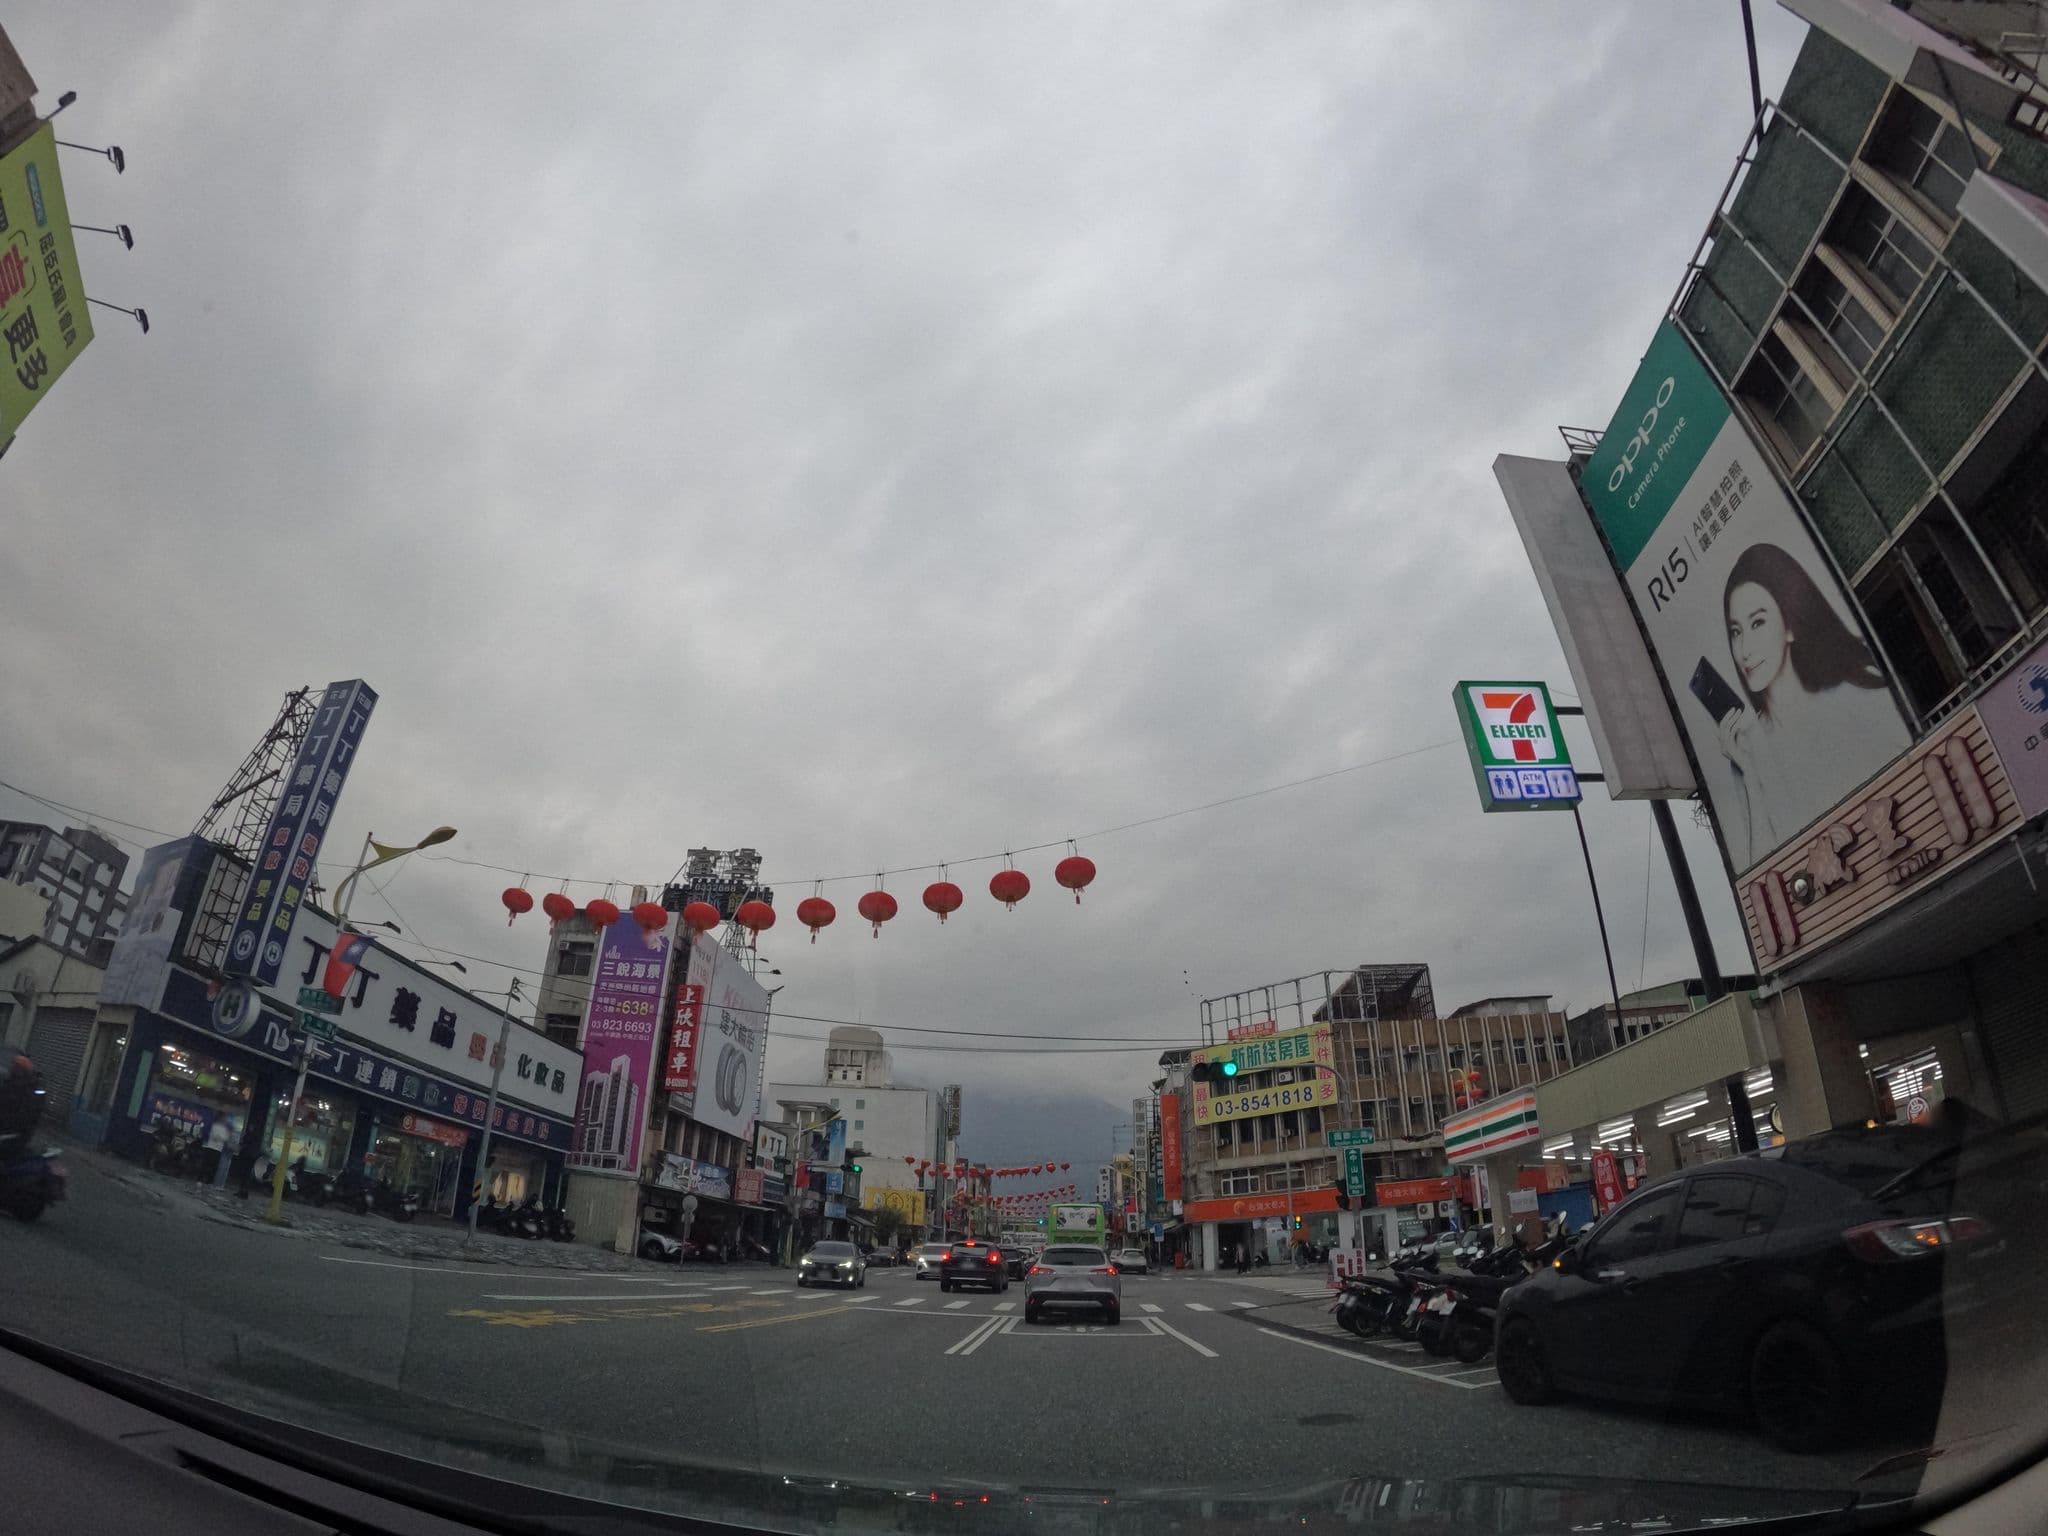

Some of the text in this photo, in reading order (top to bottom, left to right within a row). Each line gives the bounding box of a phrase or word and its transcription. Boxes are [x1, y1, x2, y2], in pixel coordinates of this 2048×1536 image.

[3, 304, 49, 392] 更多
[1628, 415, 1688, 510] Camera Phone
[1647, 547, 1690, 613] R15
[1522, 773, 1543, 782] ATM
[591, 1020, 652, 1034] 03 823 6693
[621, 1000, 650, 1016] 638
[668, 987, 697, 1074] 上欣租車
[1215, 1086, 1313, 1116] 03-8541818
